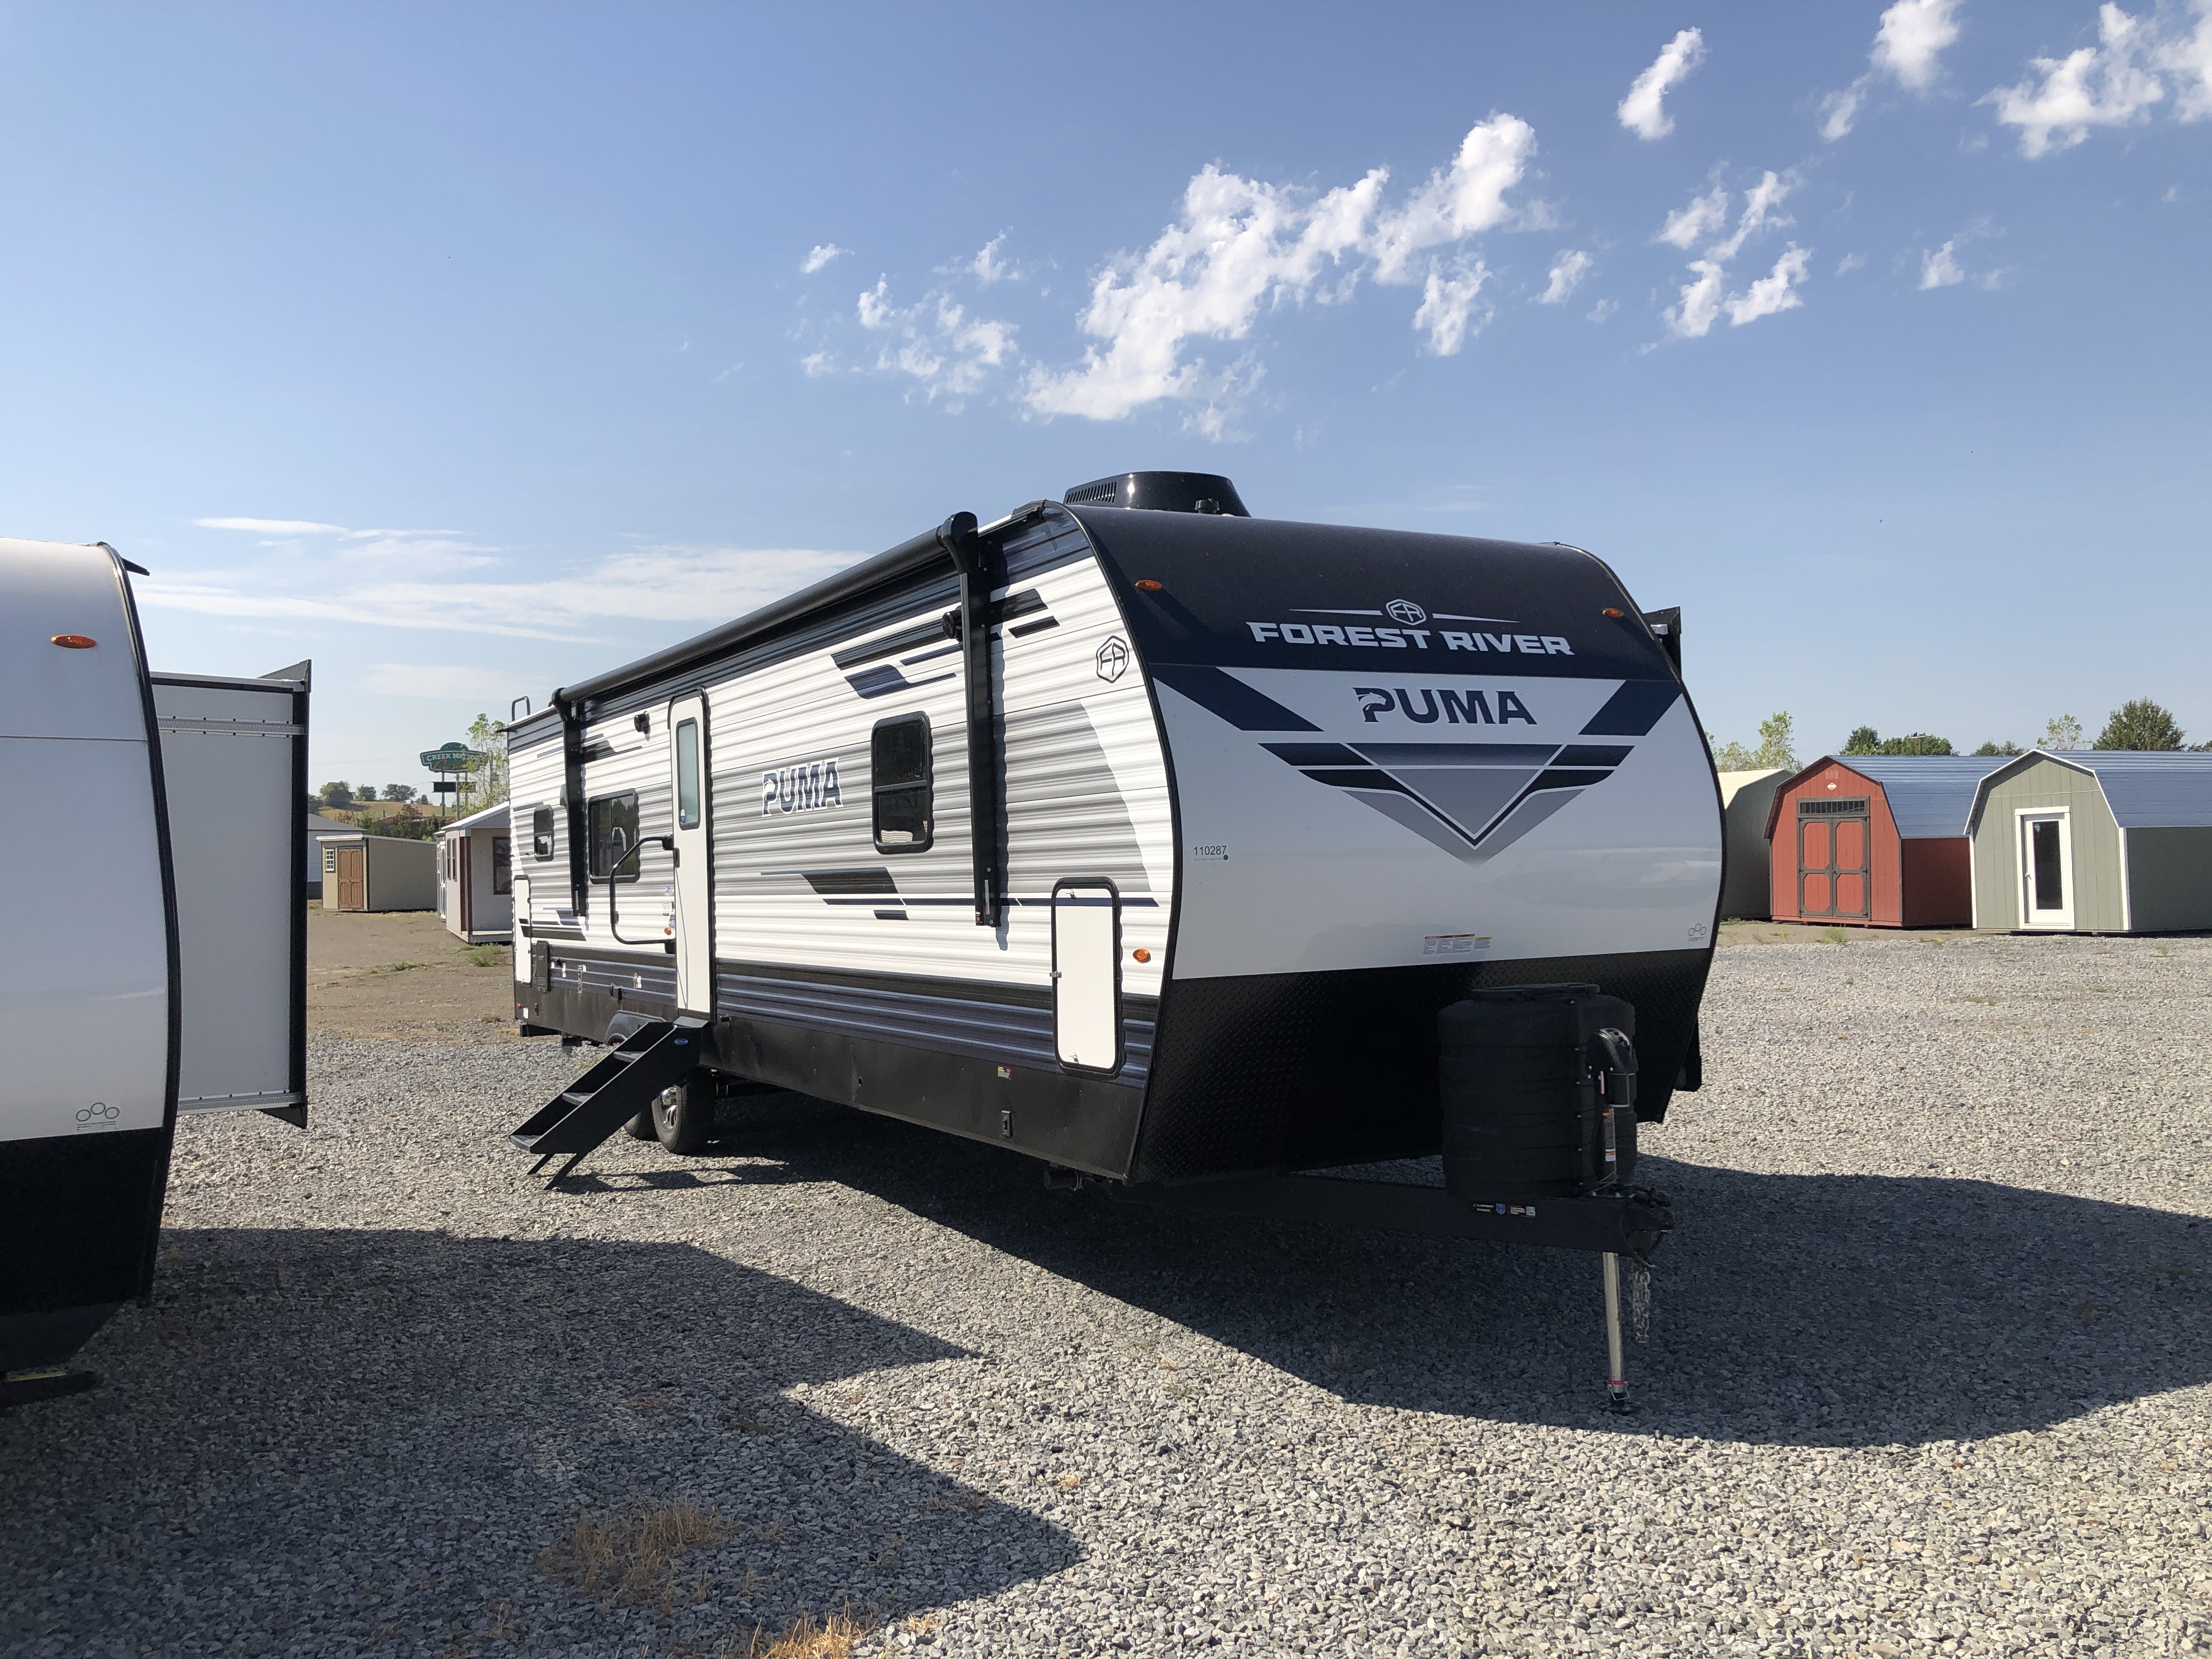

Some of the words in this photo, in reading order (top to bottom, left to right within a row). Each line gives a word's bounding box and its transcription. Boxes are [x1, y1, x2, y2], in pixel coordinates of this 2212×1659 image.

[1245, 621, 1432, 649] FOREST
[1438, 630, 1575, 656] RIVER
[1352, 687, 1538, 725] PUMA
[426, 753, 452, 762] CREEK
[453, 753, 482, 761] NATIO
[761, 757, 844, 817] PUMA
[1193, 845, 1227, 856] 110287
